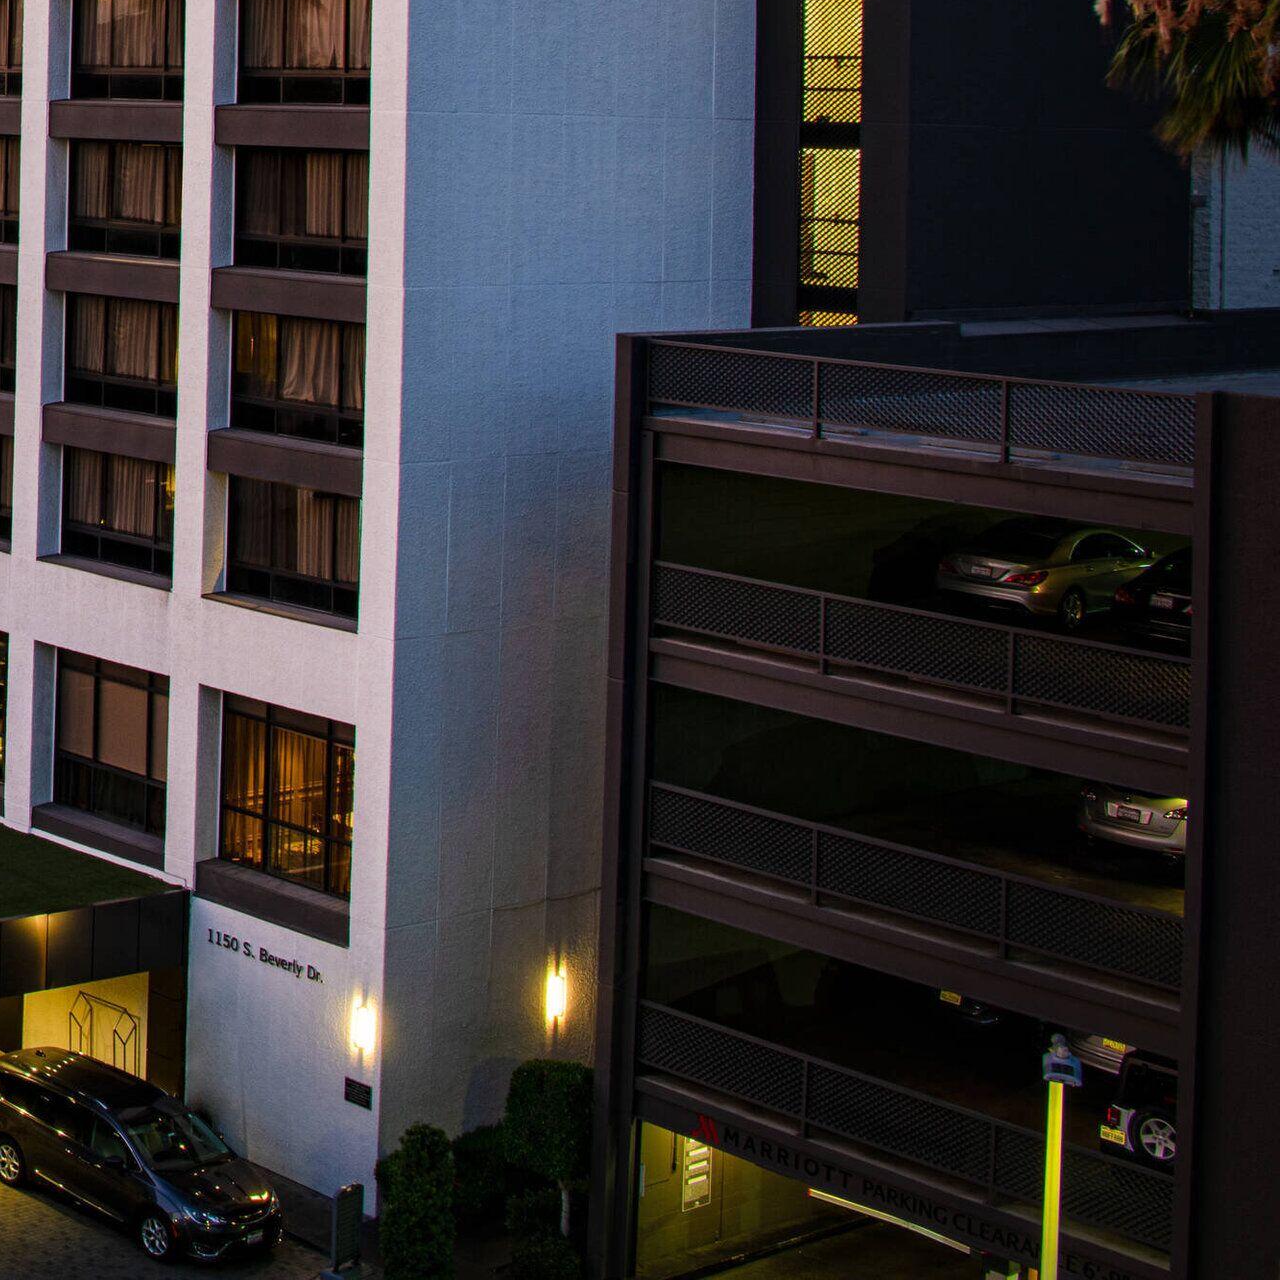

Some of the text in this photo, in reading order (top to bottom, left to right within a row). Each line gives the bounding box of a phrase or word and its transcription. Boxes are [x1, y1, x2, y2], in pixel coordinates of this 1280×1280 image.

[208, 928, 324, 983] 1150 S. Beverly Dr.
[723, 1128, 854, 1190] MARRIOTT
[863, 1180, 947, 1225] PARKING
[954, 1212, 1080, 1275] CLEARAE
